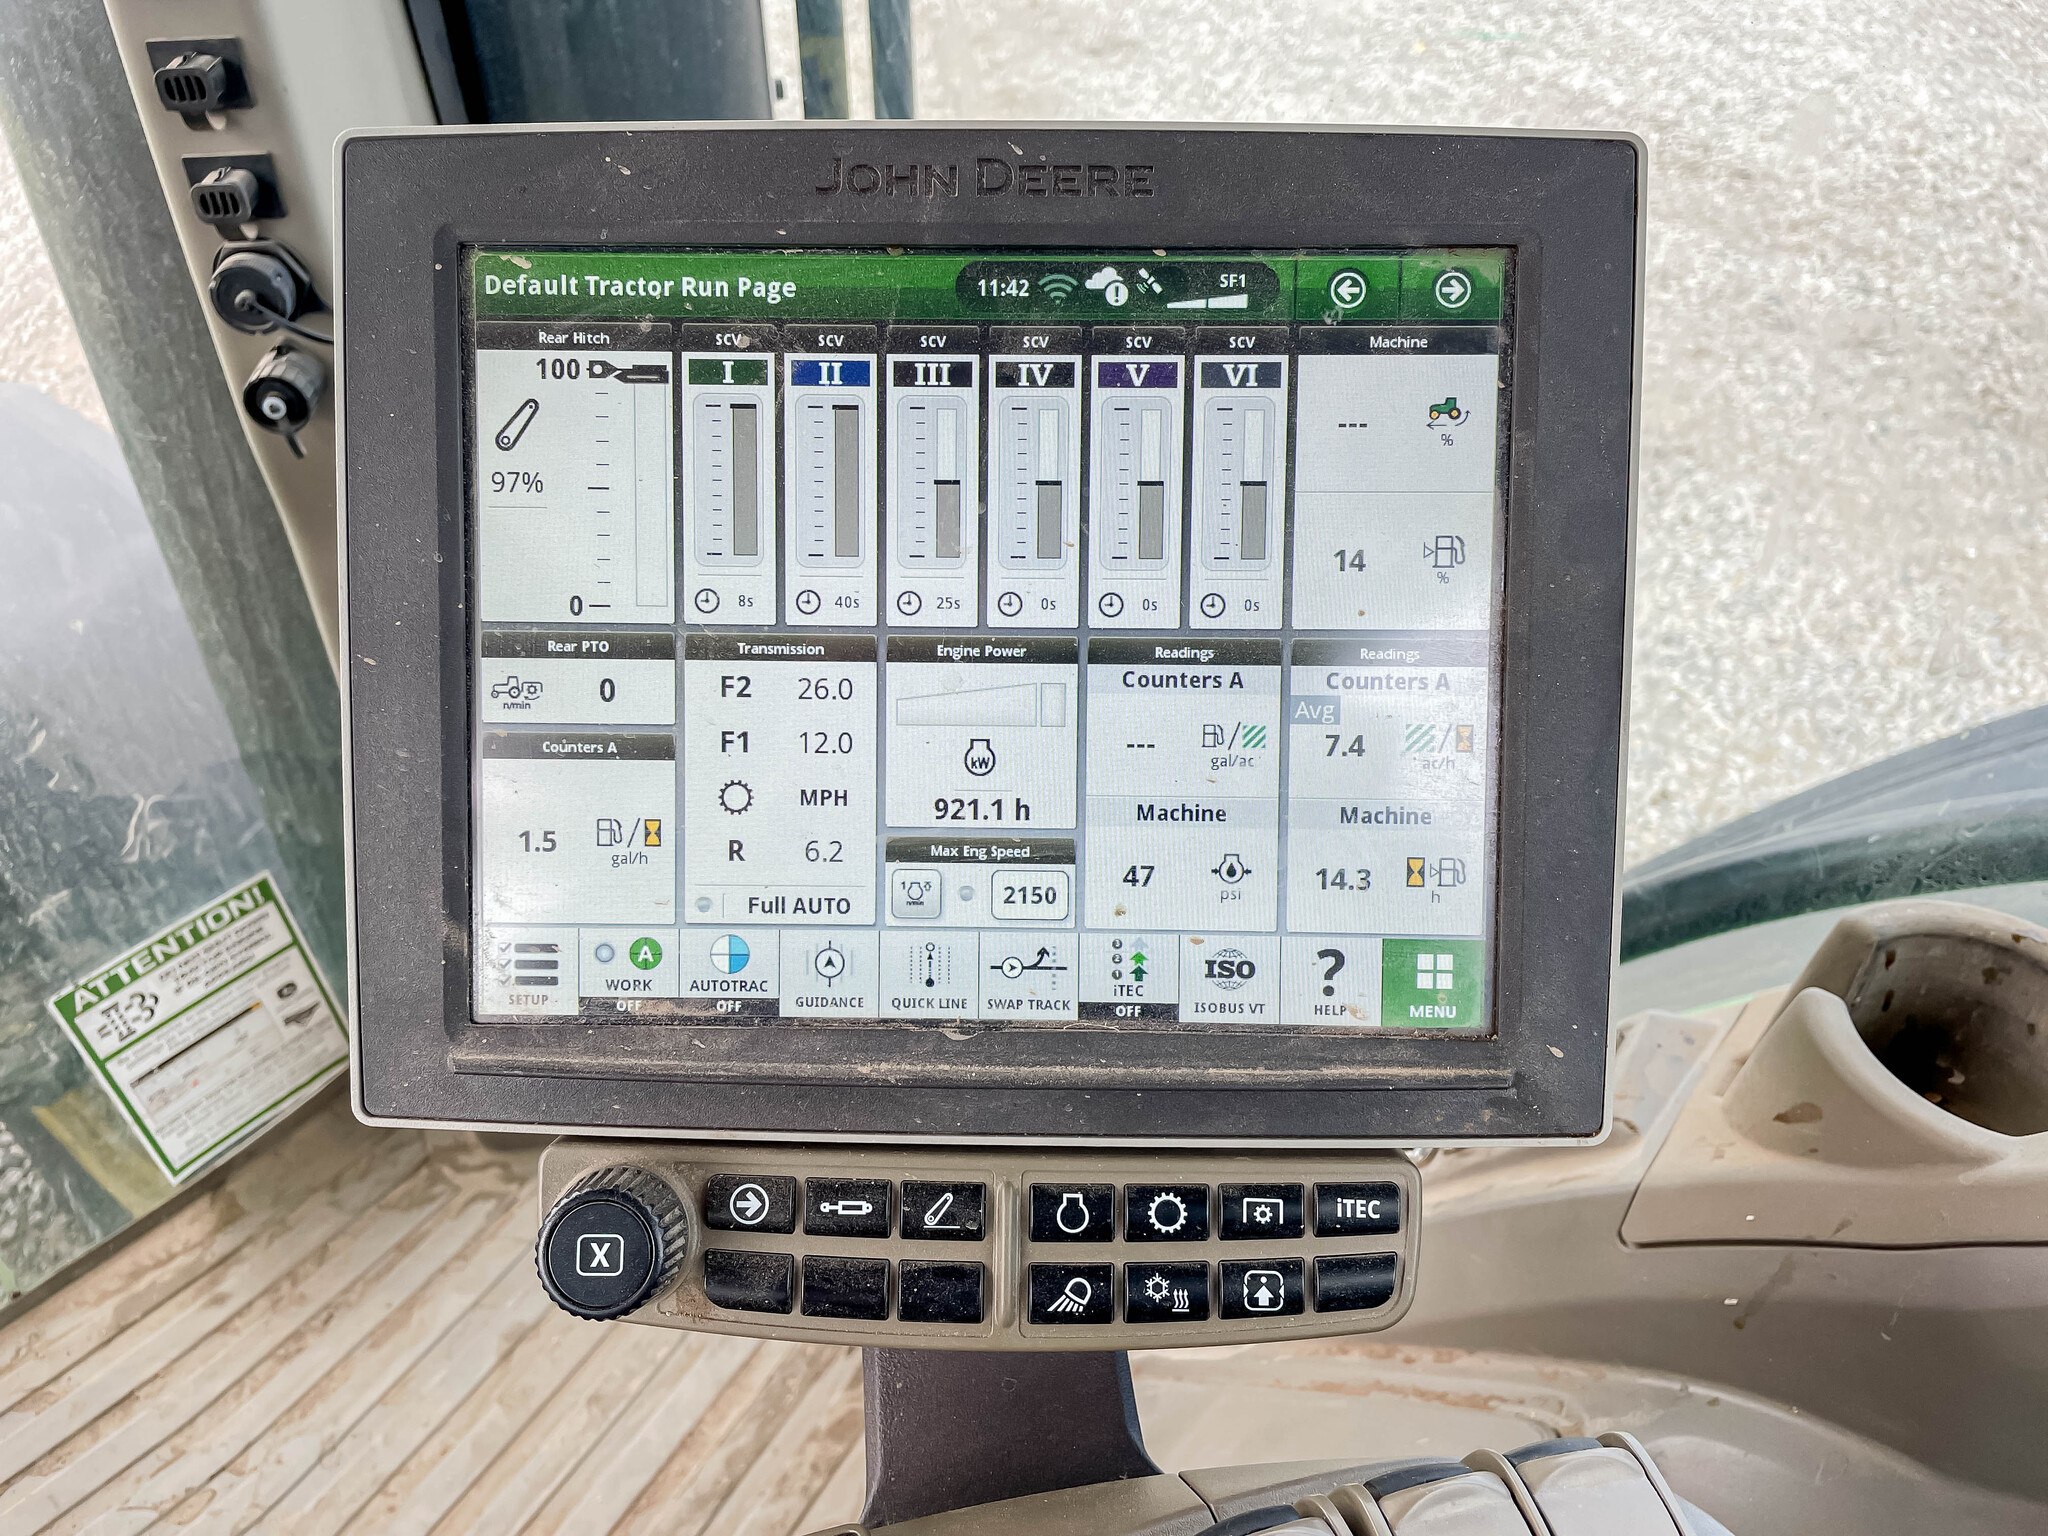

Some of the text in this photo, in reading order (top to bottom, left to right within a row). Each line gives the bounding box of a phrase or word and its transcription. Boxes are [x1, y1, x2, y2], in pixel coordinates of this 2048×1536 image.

[815, 157, 1155, 198] JOHN DEERE
[977, 279, 1030, 297] 11:42
[1219, 274, 1247, 288] SF1
[485, 274, 797, 304] Default Tractor Run Page
[538, 332, 610, 345] Rear Hitch
[715, 334, 741, 346] SCV
[818, 334, 844, 347] SCV
[920, 335, 947, 348] SCV
[1022, 335, 1049, 348] SCV
[1125, 336, 1152, 349] SCV
[1229, 336, 1255, 349] SCV
[1369, 336, 1428, 349] Machine
[536, 358, 580, 380] 100
[722, 361, 734, 383] I
[818, 362, 843, 385] II
[914, 363, 951, 386] III
[1018, 363, 1054, 386] IV
[1125, 364, 1150, 387] V
[1223, 364, 1258, 387] VI
[1440, 433, 1454, 447] %
[491, 471, 544, 493] 97%
[1333, 549, 1367, 572] 14
[1436, 571, 1450, 584] %
[569, 595, 583, 616] 0
[738, 594, 753, 608] 8s
[834, 595, 860, 609] 40s
[936, 596, 960, 610] 25s
[1041, 597, 1057, 611] 0s
[1142, 598, 1158, 611] 0s
[1244, 598, 1260, 612] 0s
[547, 640, 610, 653] Rear PTO
[737, 642, 825, 656] Transmission
[937, 644, 1027, 661] Engine Power
[1155, 646, 1214, 662] Readings
[1360, 648, 1420, 663] Readings
[1122, 670, 1244, 689] Counters A
[1326, 672, 1451, 691] Counters A
[600, 678, 616, 702] 0
[721, 675, 853, 700] F2 26.0
[503, 701, 531, 710] n/min
[1294, 702, 1336, 724] Avg
[542, 741, 618, 754] Counters A
[721, 731, 853, 755] F1 12.0
[1325, 734, 1365, 757] 7.4
[971, 757, 990, 769] kW
[1211, 754, 1254, 770] gal/ac
[1422, 756, 1456, 771] ac/h
[799, 789, 848, 807] MPH
[934, 798, 1030, 821] 921.1 h
[1136, 804, 1227, 822] Machine
[1340, 806, 1432, 825] Machine
[518, 830, 557, 853] 1.5
[728, 839, 844, 863] R 6.2
[931, 846, 1030, 860] Max Eng Speed
[611, 852, 648, 869] gal/h
[1122, 865, 1155, 888] 47
[1315, 868, 1372, 891] 14.3
[1003, 886, 1057, 905] 2150
[1220, 888, 1242, 903] psi
[1431, 890, 1441, 904] h
[748, 896, 851, 915] Full AUTO
[74, 885, 266, 1015] ATTENTION!
[637, 945, 655, 963] A
[1204, 959, 1256, 981] ISO
[605, 979, 652, 992] WORK
[690, 980, 768, 992] AUTOTRAC
[1113, 985, 1144, 997] iTEC
[509, 994, 549, 1006] SETUP
[616, 1000, 642, 1012] OFF
[716, 1000, 742, 1012] OFF
[796, 997, 864, 1009] GUIDANCE
[891, 998, 968, 1010] QUICK LINE
[987, 999, 1071, 1011] SWAP TRACK
[1115, 1006, 1142, 1017] OFF
[1193, 1002, 1266, 1015] ISOBUS VT
[1314, 1004, 1347, 1016] HELP
[1409, 1005, 1457, 1019] MENU
[1337, 1197, 1381, 1219] iTEC
[590, 1242, 611, 1268] X
